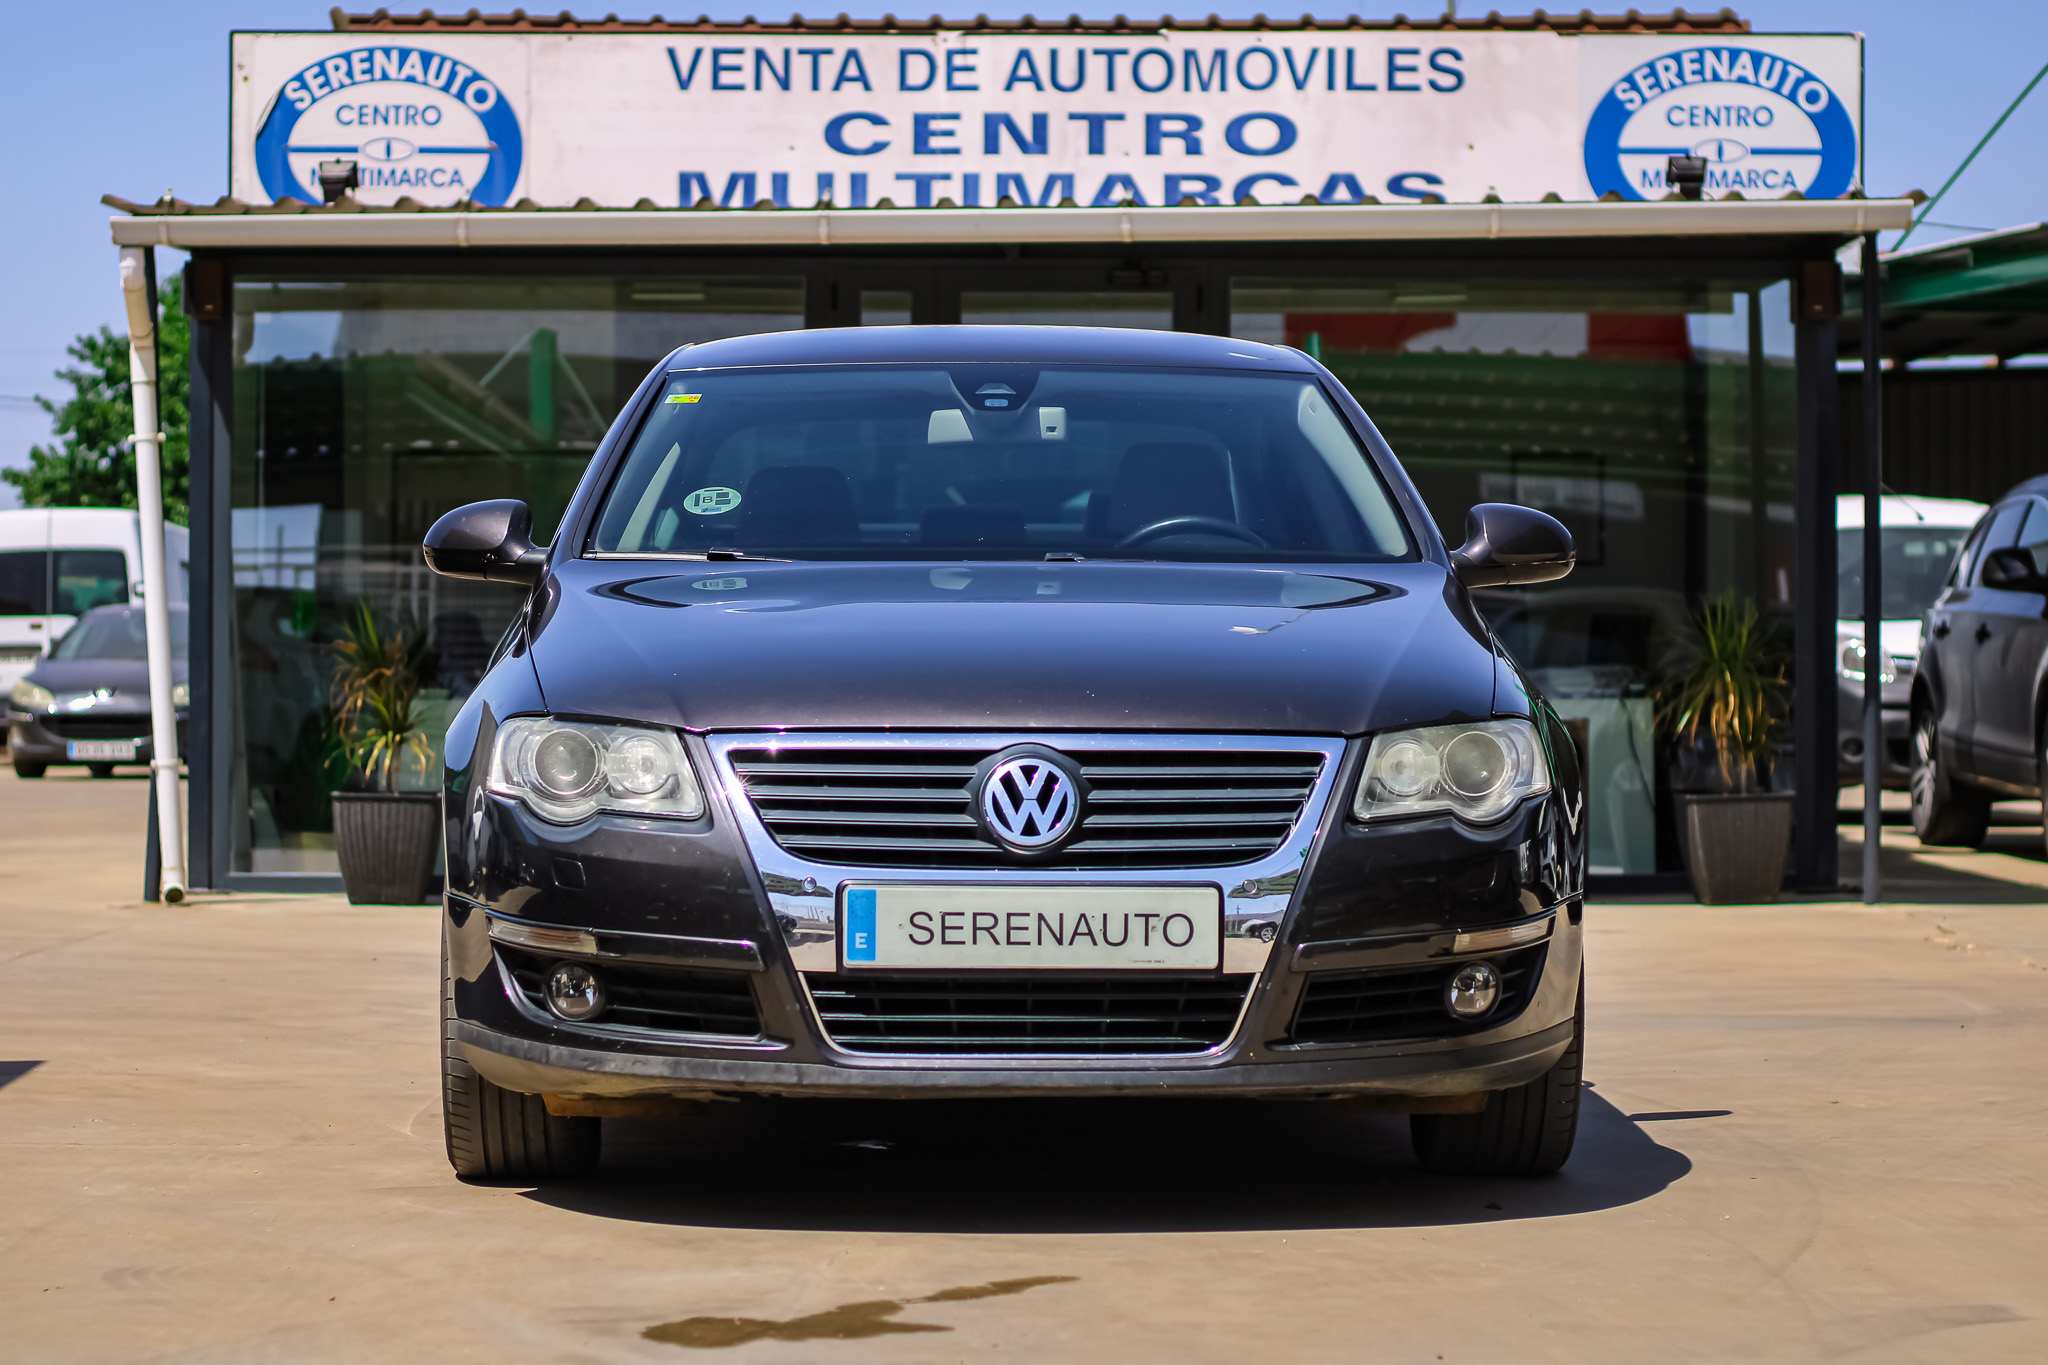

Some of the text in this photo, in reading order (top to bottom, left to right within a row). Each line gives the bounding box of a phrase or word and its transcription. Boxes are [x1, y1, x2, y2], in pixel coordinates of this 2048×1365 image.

[284, 49, 498, 113] SERENAUTO
[666, 47, 1465, 92] VENTA DE AUTOMOVILES
[1614, 49, 1830, 114] SERENAUTO
[336, 105, 442, 126] CENTRO
[823, 111, 1298, 156] CENTRO
[1666, 106, 1774, 127] CENTRO
[1642, 169, 1797, 188] MMARCA
[985, 758, 1076, 845] VW
[855, 932, 868, 949] E
[908, 911, 1195, 947] SERENAUTO
